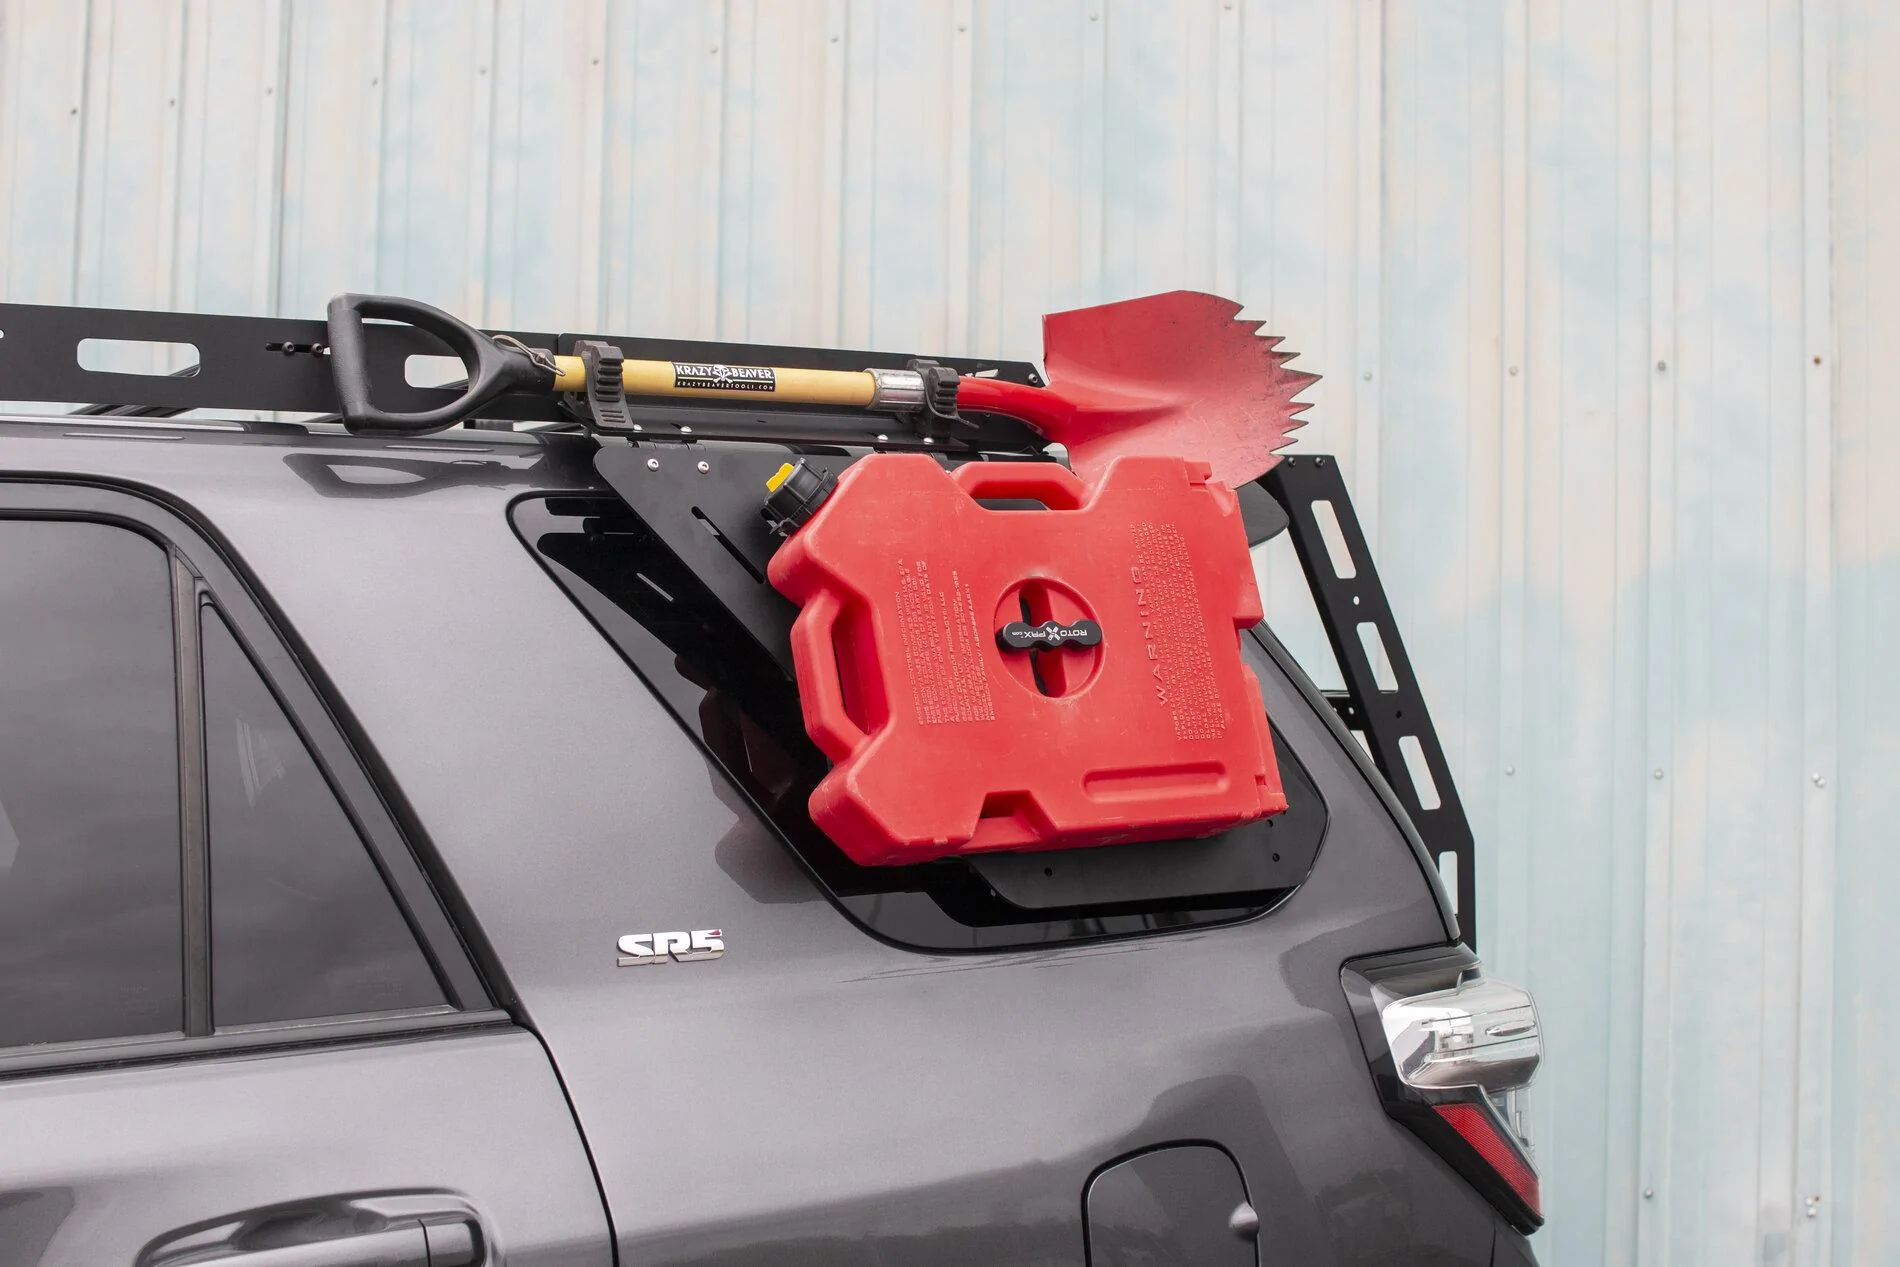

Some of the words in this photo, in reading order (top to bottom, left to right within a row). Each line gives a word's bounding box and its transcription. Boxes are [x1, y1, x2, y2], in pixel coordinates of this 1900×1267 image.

[676, 365, 712, 376] KRAZY
[730, 367, 774, 379] BEAVER
[1060, 628, 1087, 637] ROTO
[1130, 566, 1168, 705] WARNING
[617, 928, 724, 968] SR5
